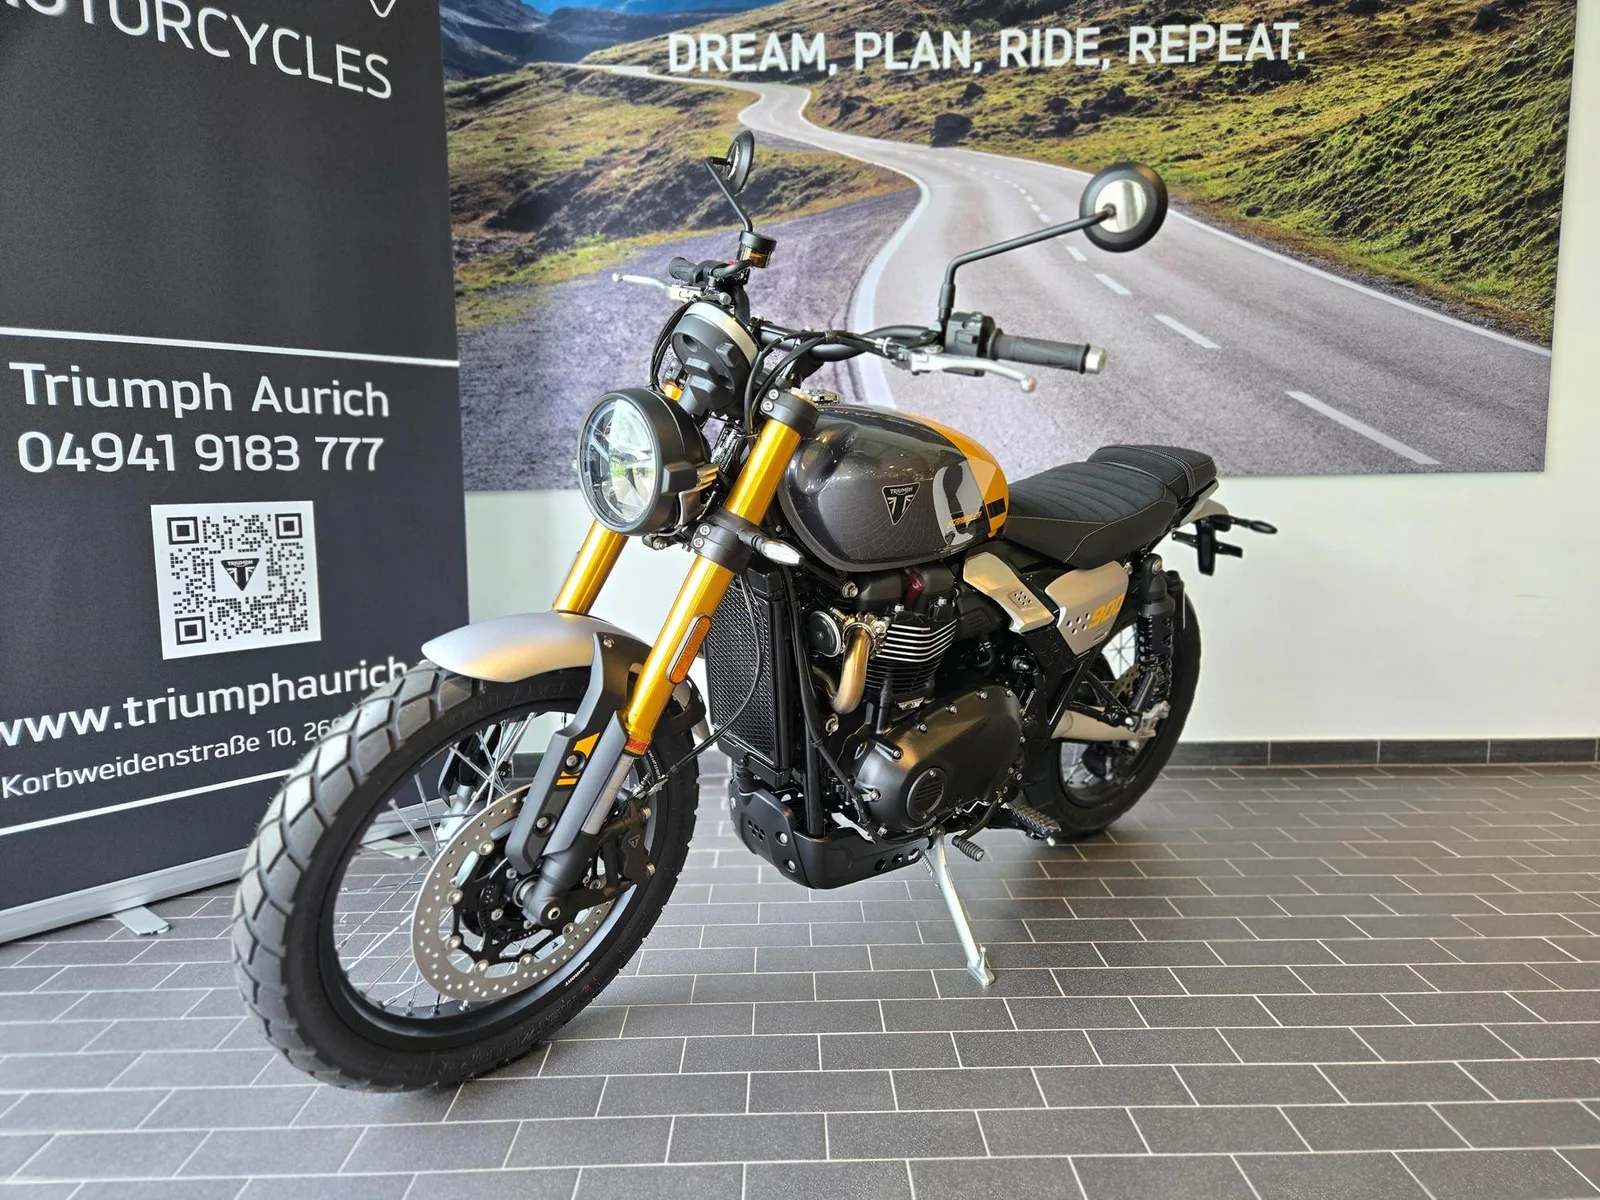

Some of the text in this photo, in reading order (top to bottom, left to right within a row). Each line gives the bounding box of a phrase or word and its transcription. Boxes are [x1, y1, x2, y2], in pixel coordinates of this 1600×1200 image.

[4, 0, 392, 99] ORCYCLES
[668, 22, 1305, 76] DREAM, PLAN, RIDE, REPEAT.
[9, 362, 389, 418] Triumph Aurich
[18, 431, 384, 473] 04941 9183 777
[1088, 592, 1127, 629] 900
[2, 734, 259, 799] Korbweidenstraße
[267, 727, 297, 748] 10,
